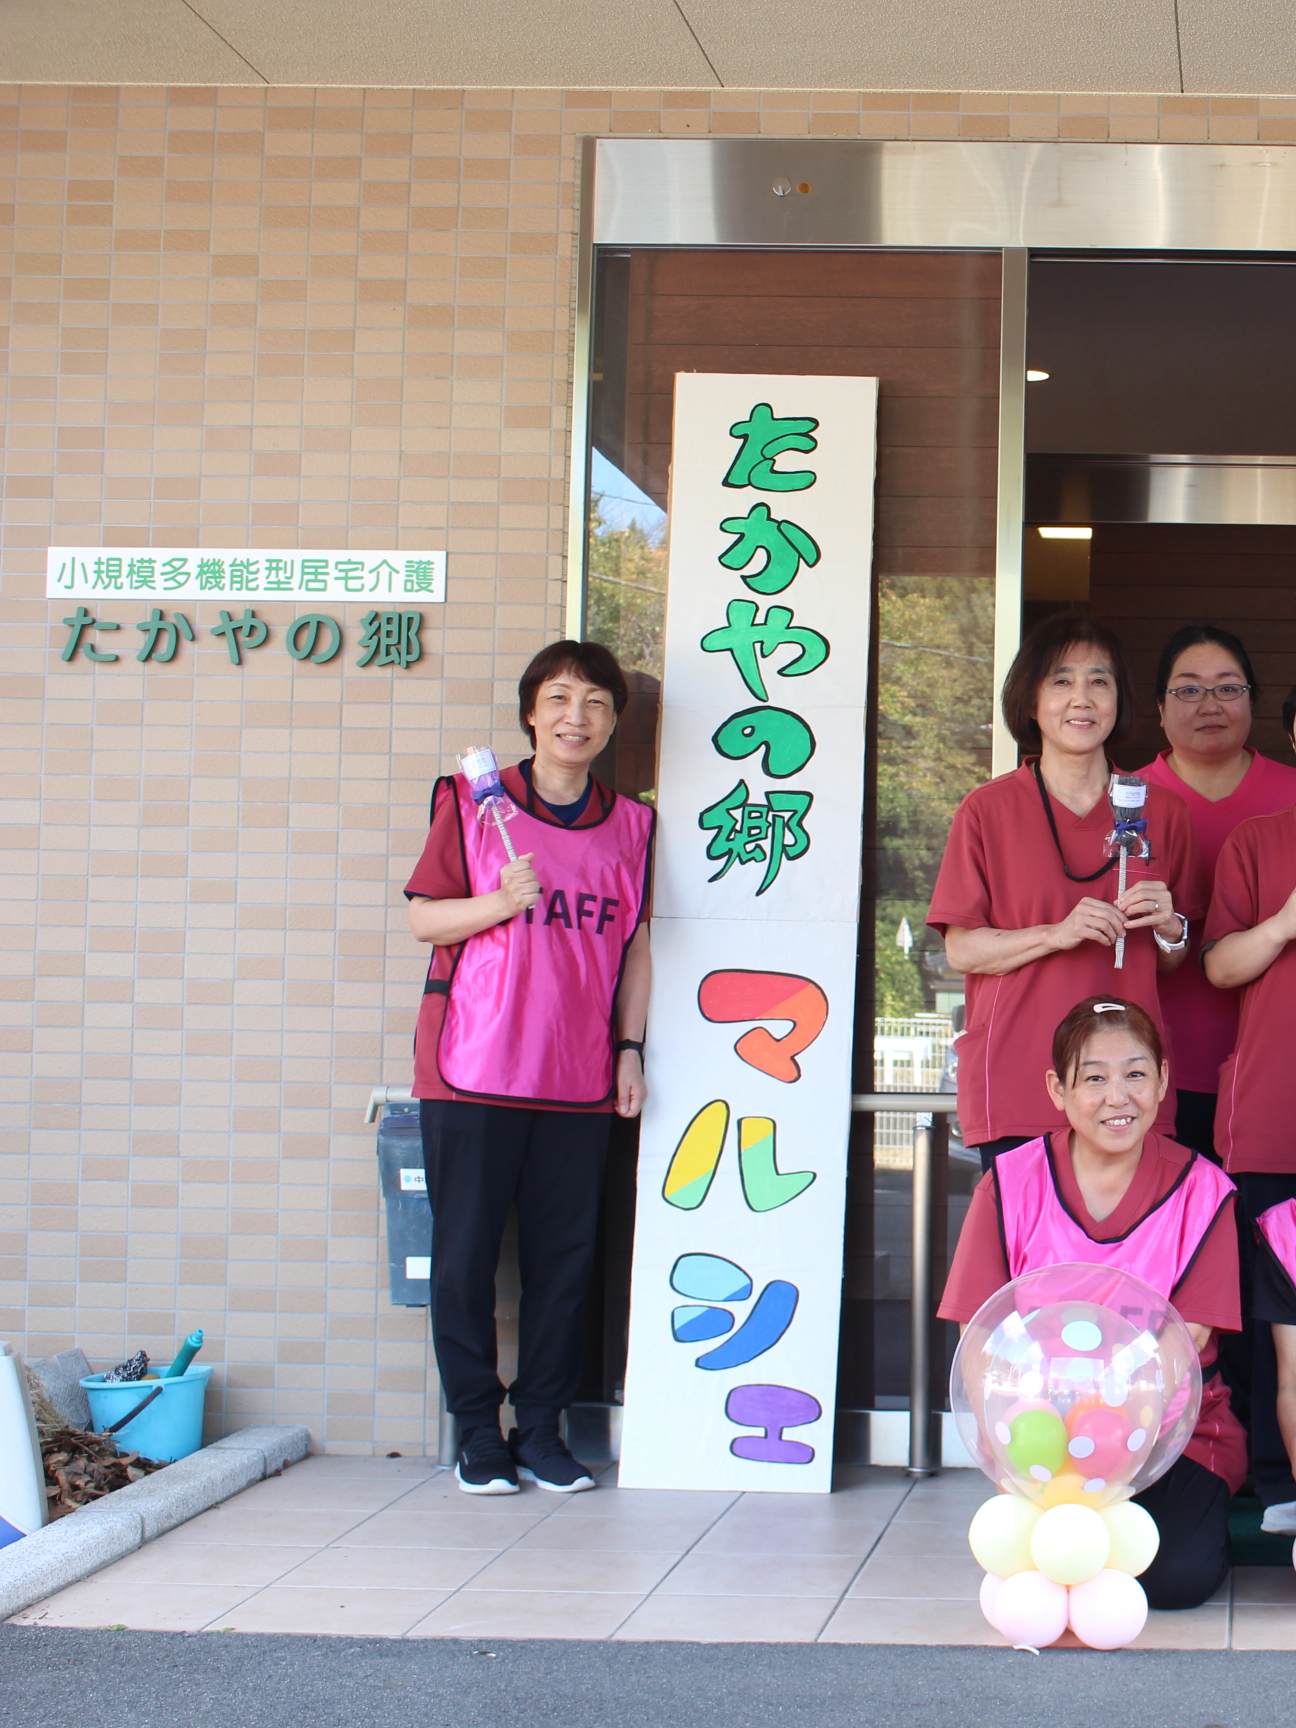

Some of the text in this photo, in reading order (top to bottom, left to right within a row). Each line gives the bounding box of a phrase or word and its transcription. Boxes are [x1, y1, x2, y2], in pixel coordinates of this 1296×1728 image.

[57, 556, 435, 594] 小規模多機能型居宅介護
[61, 606, 424, 669] たかやの郷
[662, 403, 830, 1464] たかやの郷 マルシェ
